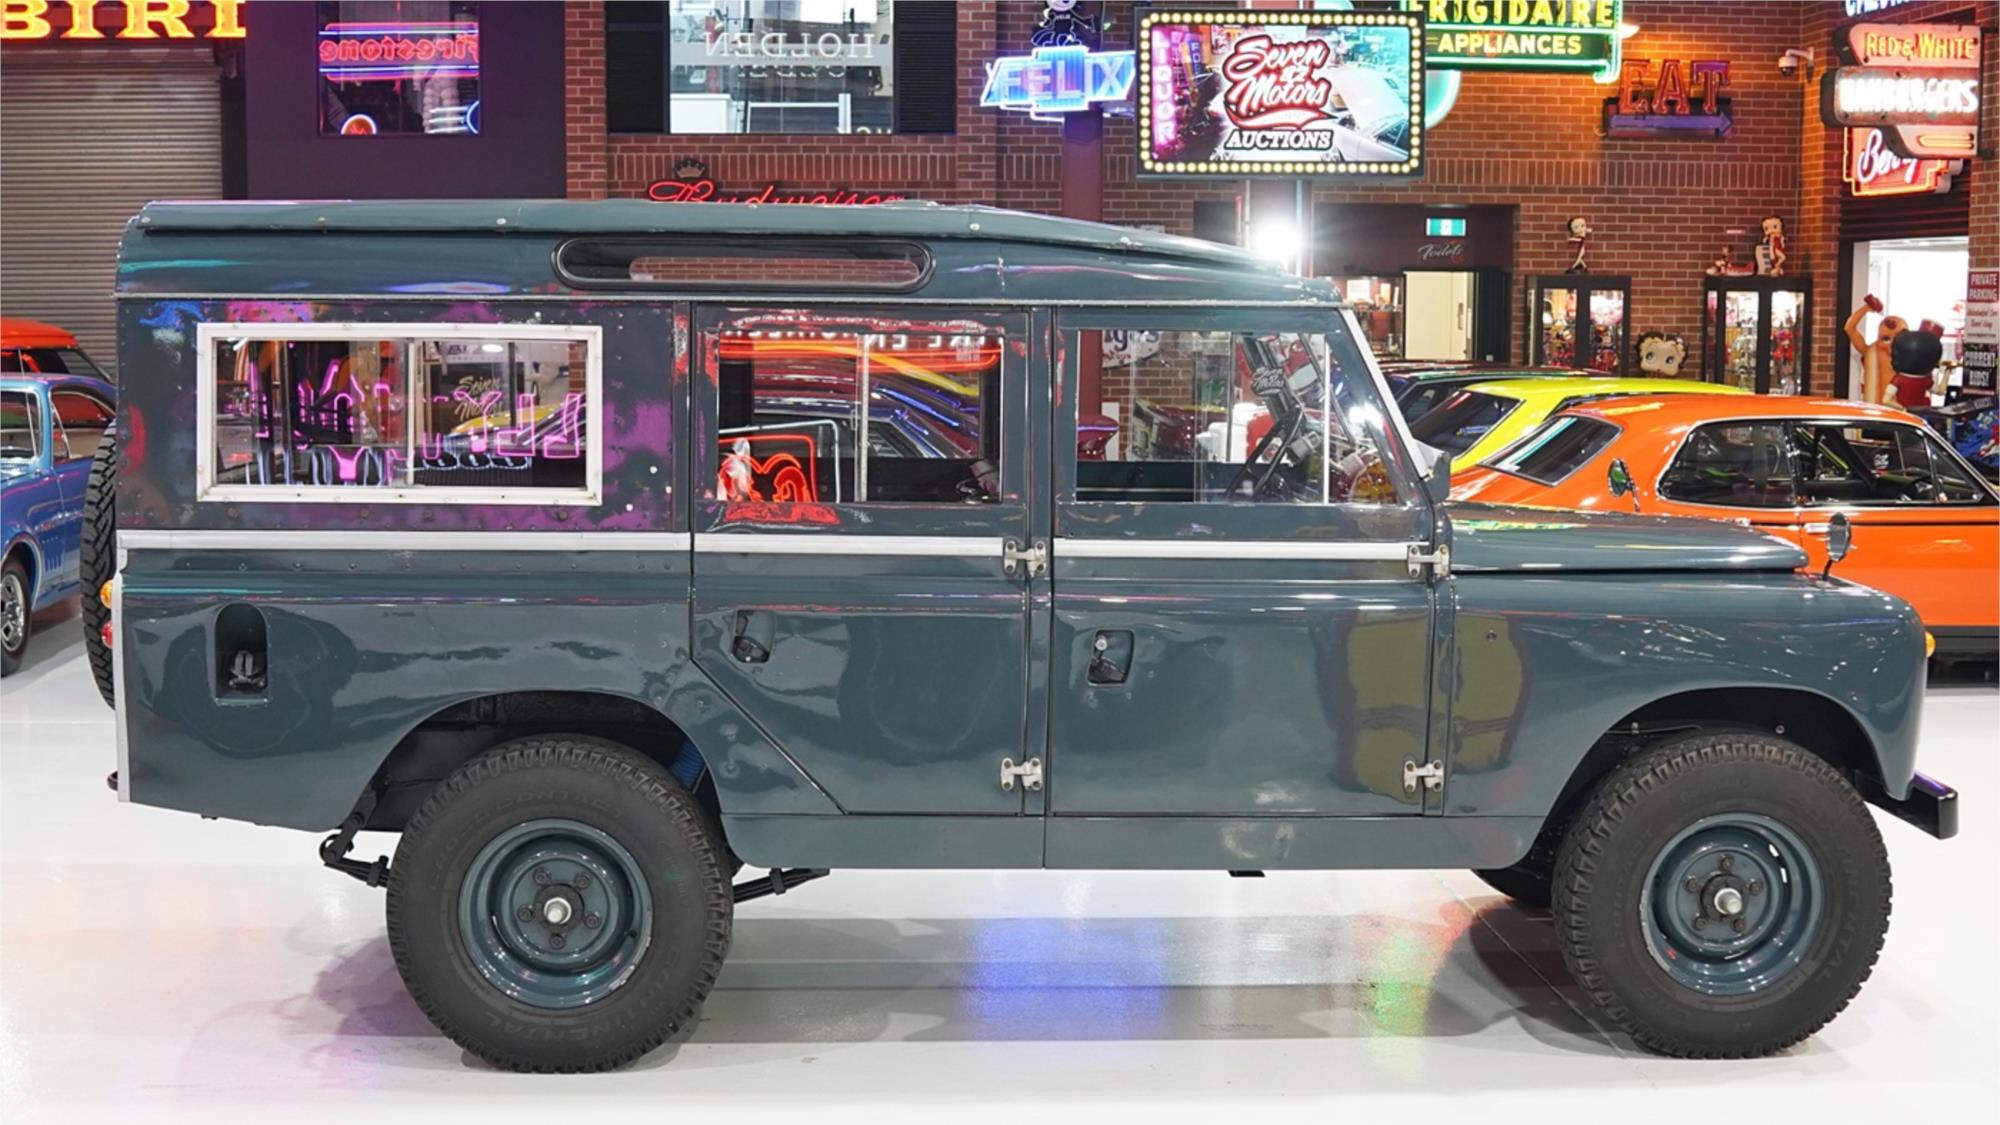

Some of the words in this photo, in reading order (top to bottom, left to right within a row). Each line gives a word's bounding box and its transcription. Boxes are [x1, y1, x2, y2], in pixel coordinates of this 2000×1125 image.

[1438, 34, 1582, 54] APPLIANCES
[1866, 33, 1902, 57] RED
[1901, 41, 1917, 59] &
[1916, 33, 1976, 59] WHITE
[1226, 38, 1326, 80] Seven
[1000, 58, 1125, 101] FELIX
[1617, 59, 1731, 115] EAT
[1227, 74, 1328, 116] Motors
[1225, 131, 1332, 149] AUCTIONS
[1417, 243, 1463, 260] Toilets
[1971, 273, 1997, 286] PRIVATE
[1969, 288, 1997, 300] PARKING
[1964, 351, 1995, 368] CURRENT
